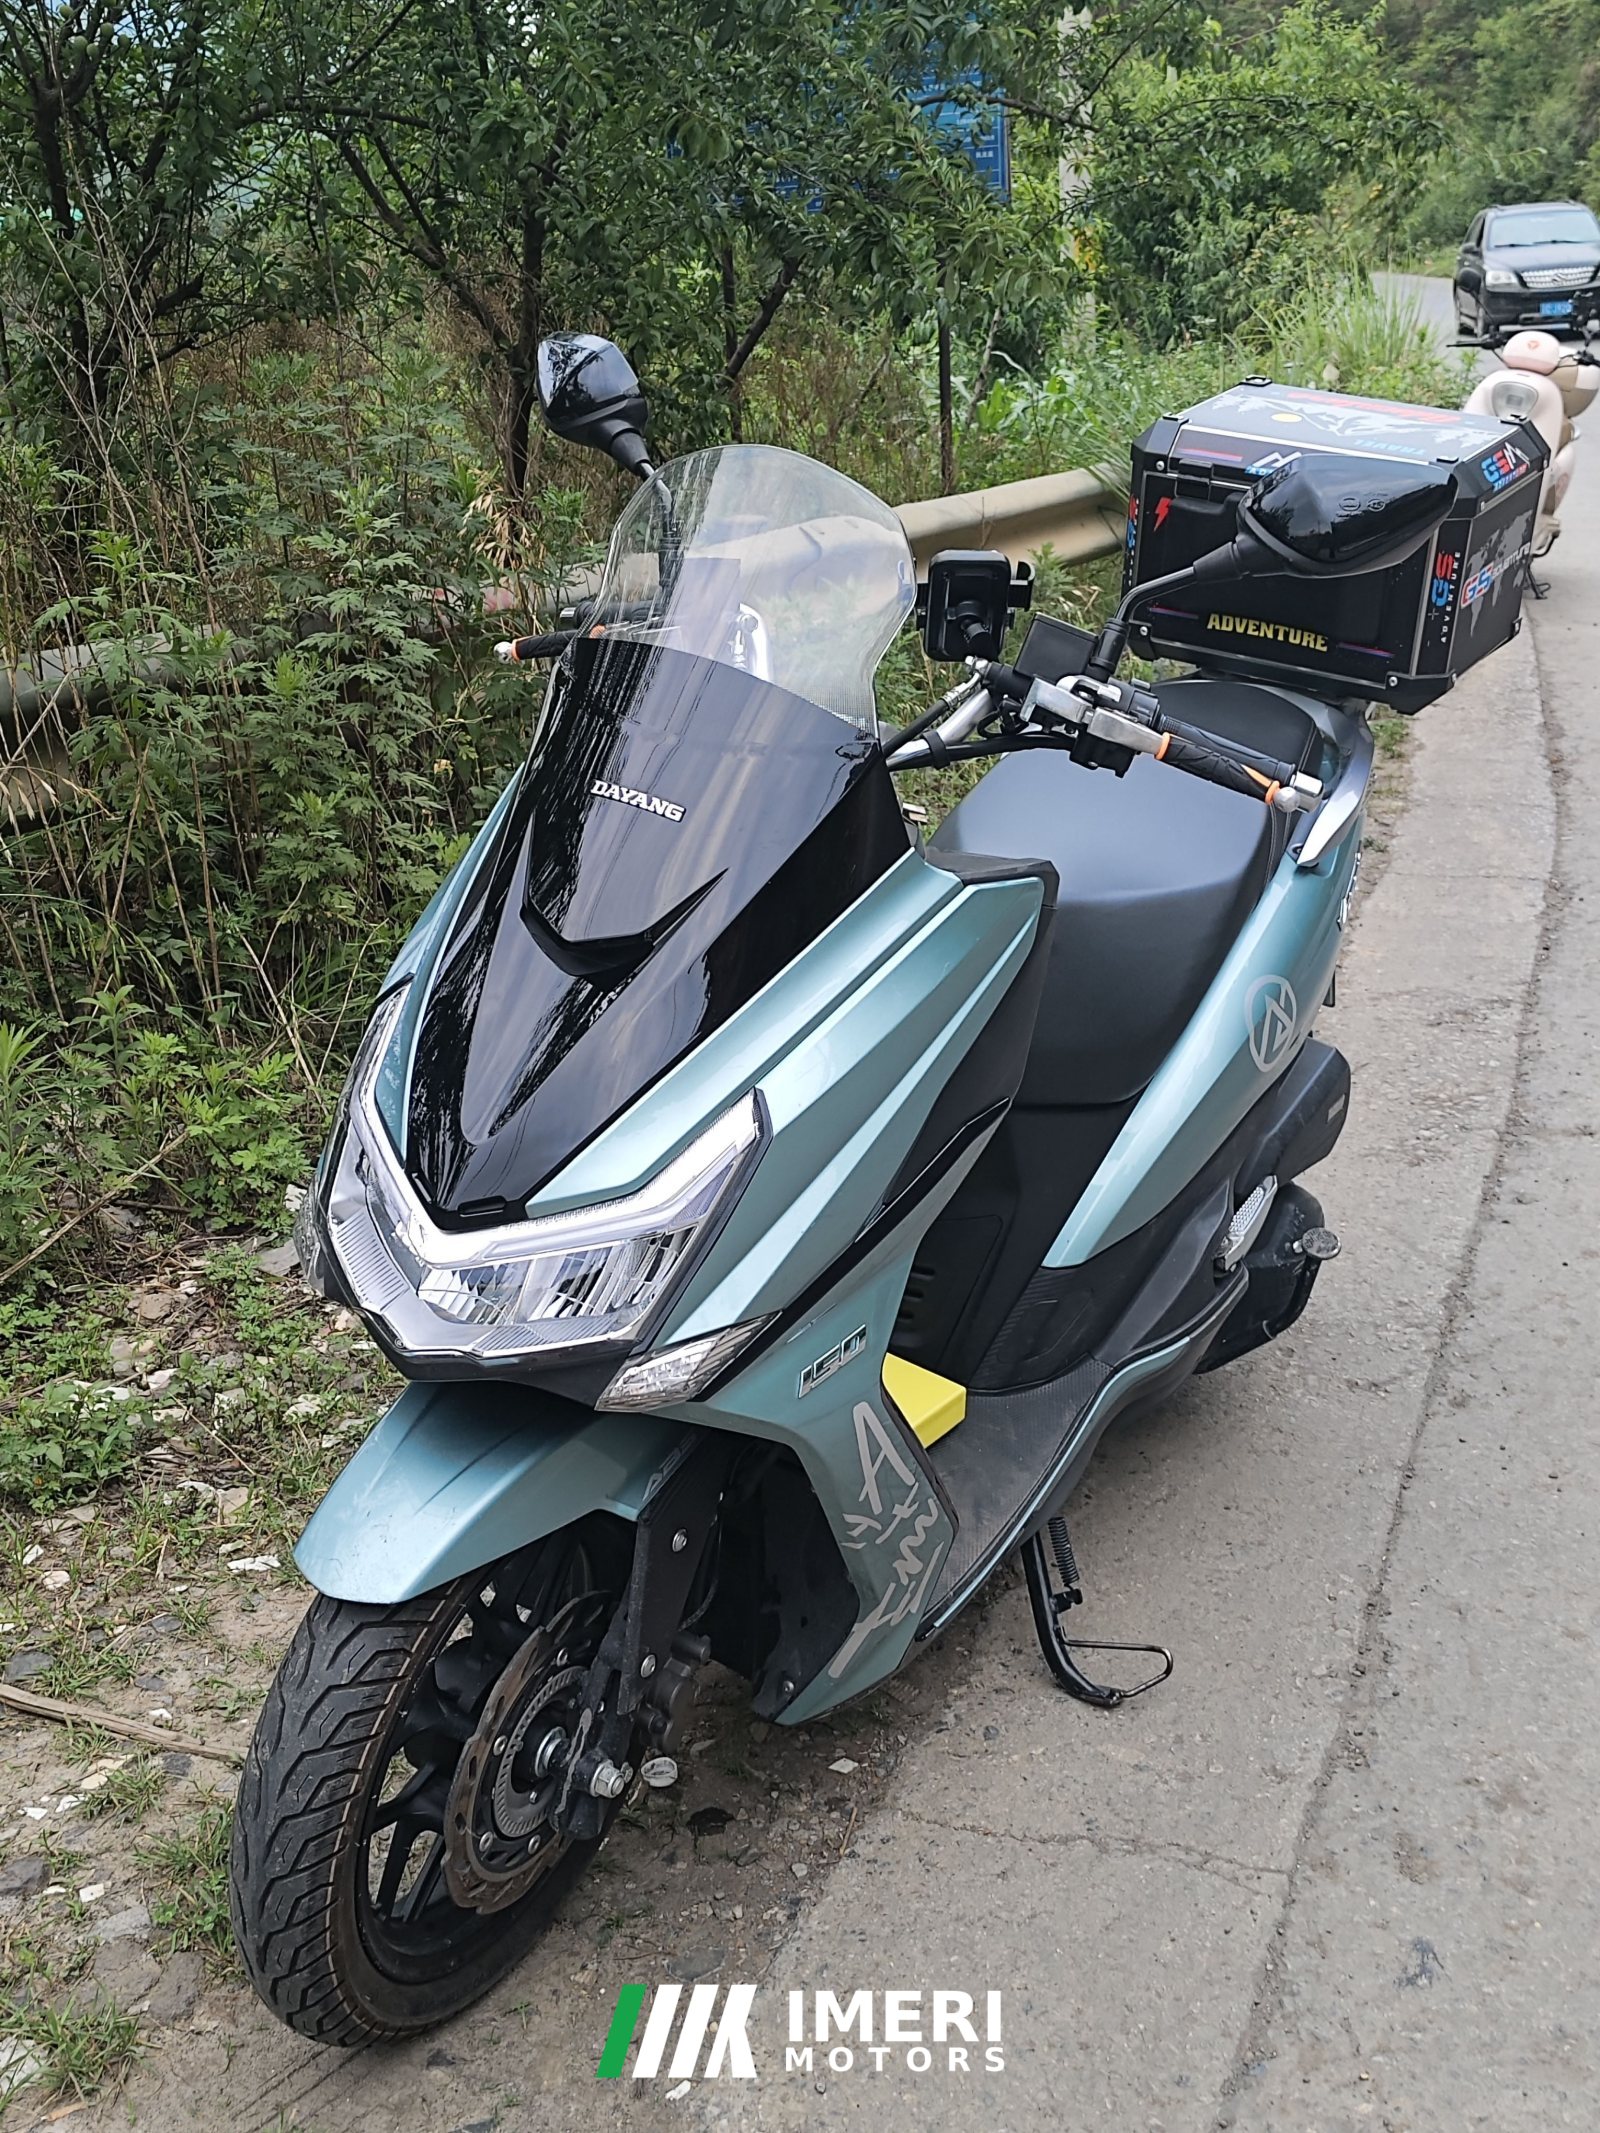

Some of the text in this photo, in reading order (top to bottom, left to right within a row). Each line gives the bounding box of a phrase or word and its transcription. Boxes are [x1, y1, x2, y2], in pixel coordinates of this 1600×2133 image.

[1440, 551, 1461, 643] ADVENTURE
[1206, 613, 1329, 652] ADVENTURE
[591, 779, 686, 822] DAYANG
[798, 1323, 867, 1399] 150
